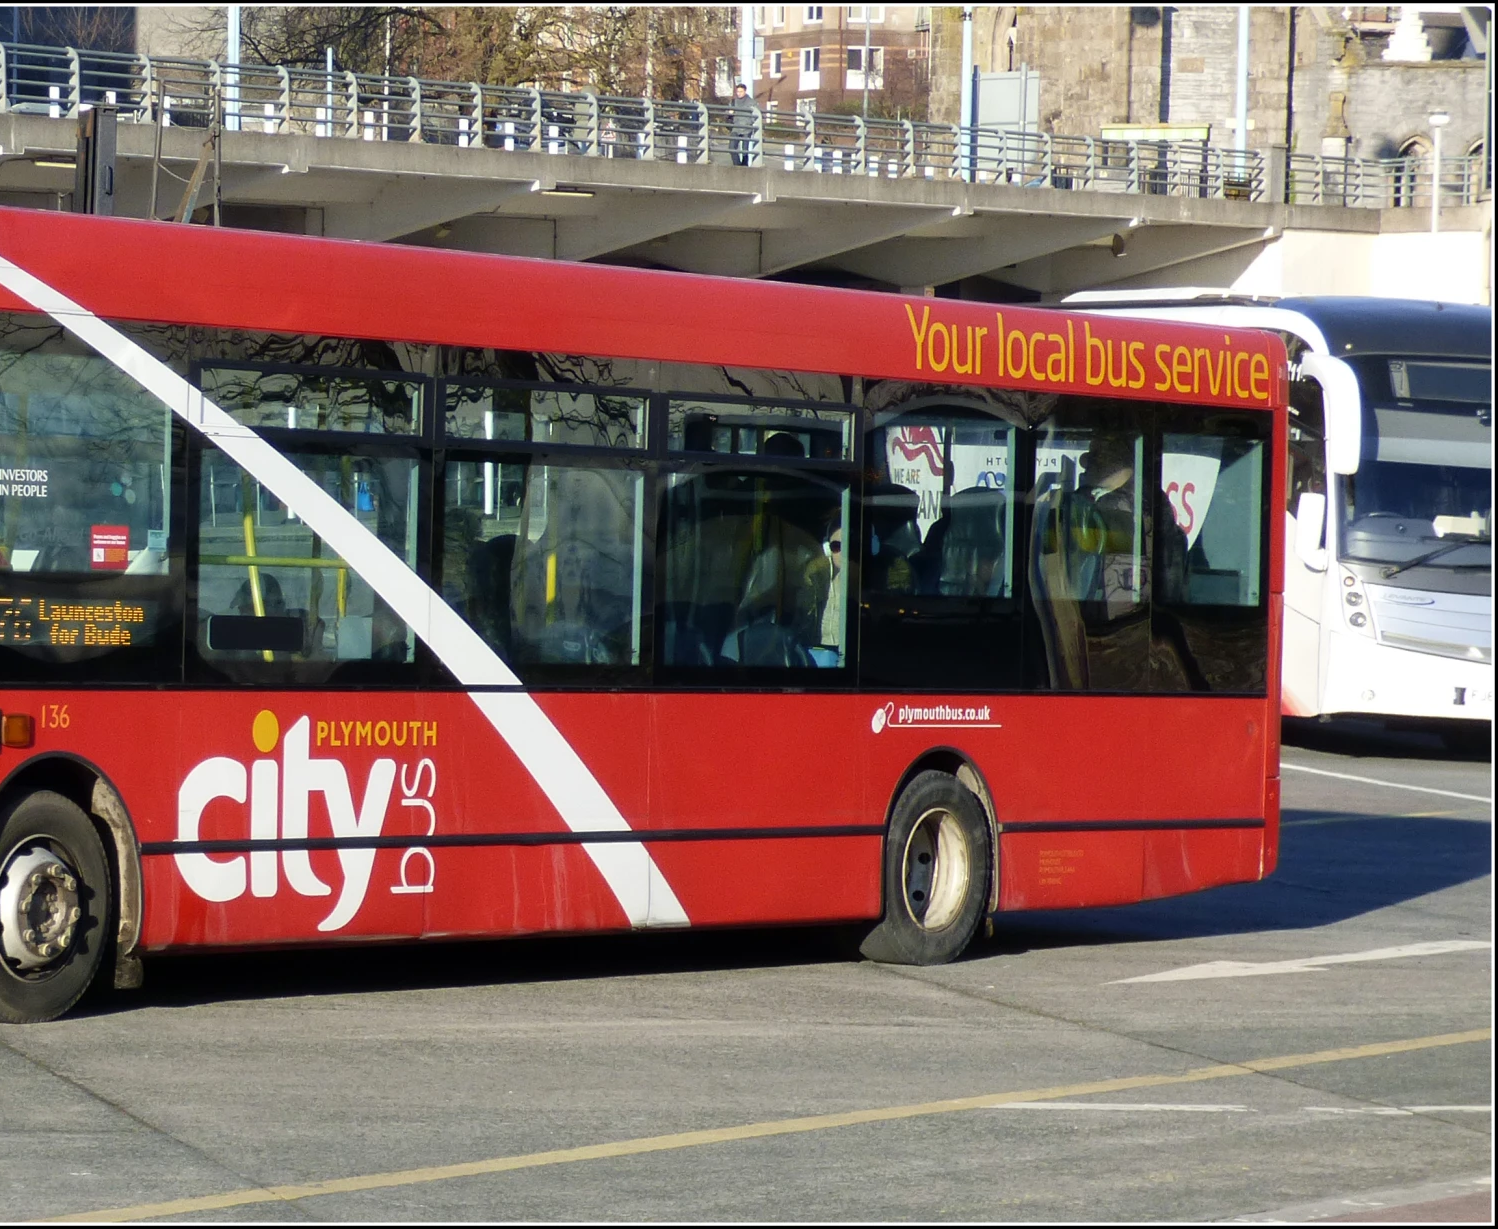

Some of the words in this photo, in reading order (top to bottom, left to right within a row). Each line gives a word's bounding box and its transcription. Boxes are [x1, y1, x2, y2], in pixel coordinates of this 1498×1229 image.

[904, 303, 988, 375] Your
[996, 312, 1075, 383] local
[1083, 320, 1146, 390] bus
[1154, 335, 1270, 400] service
[0, 469, 48, 482] INVESTORS
[905, 468, 921, 485] ARE
[0, 484, 10, 496] IN
[11, 484, 48, 497] PEOPLE
[39, 599, 144, 622] Launceston
[49, 623, 79, 645] for
[84, 624, 131, 645] Bude
[41, 704, 70, 729] 136
[899, 705, 991, 723] plymouthbus.co.uk
[316, 720, 438, 748] PLYMOUTH
[174, 709, 397, 932] city
[390, 757, 437, 895] bus
